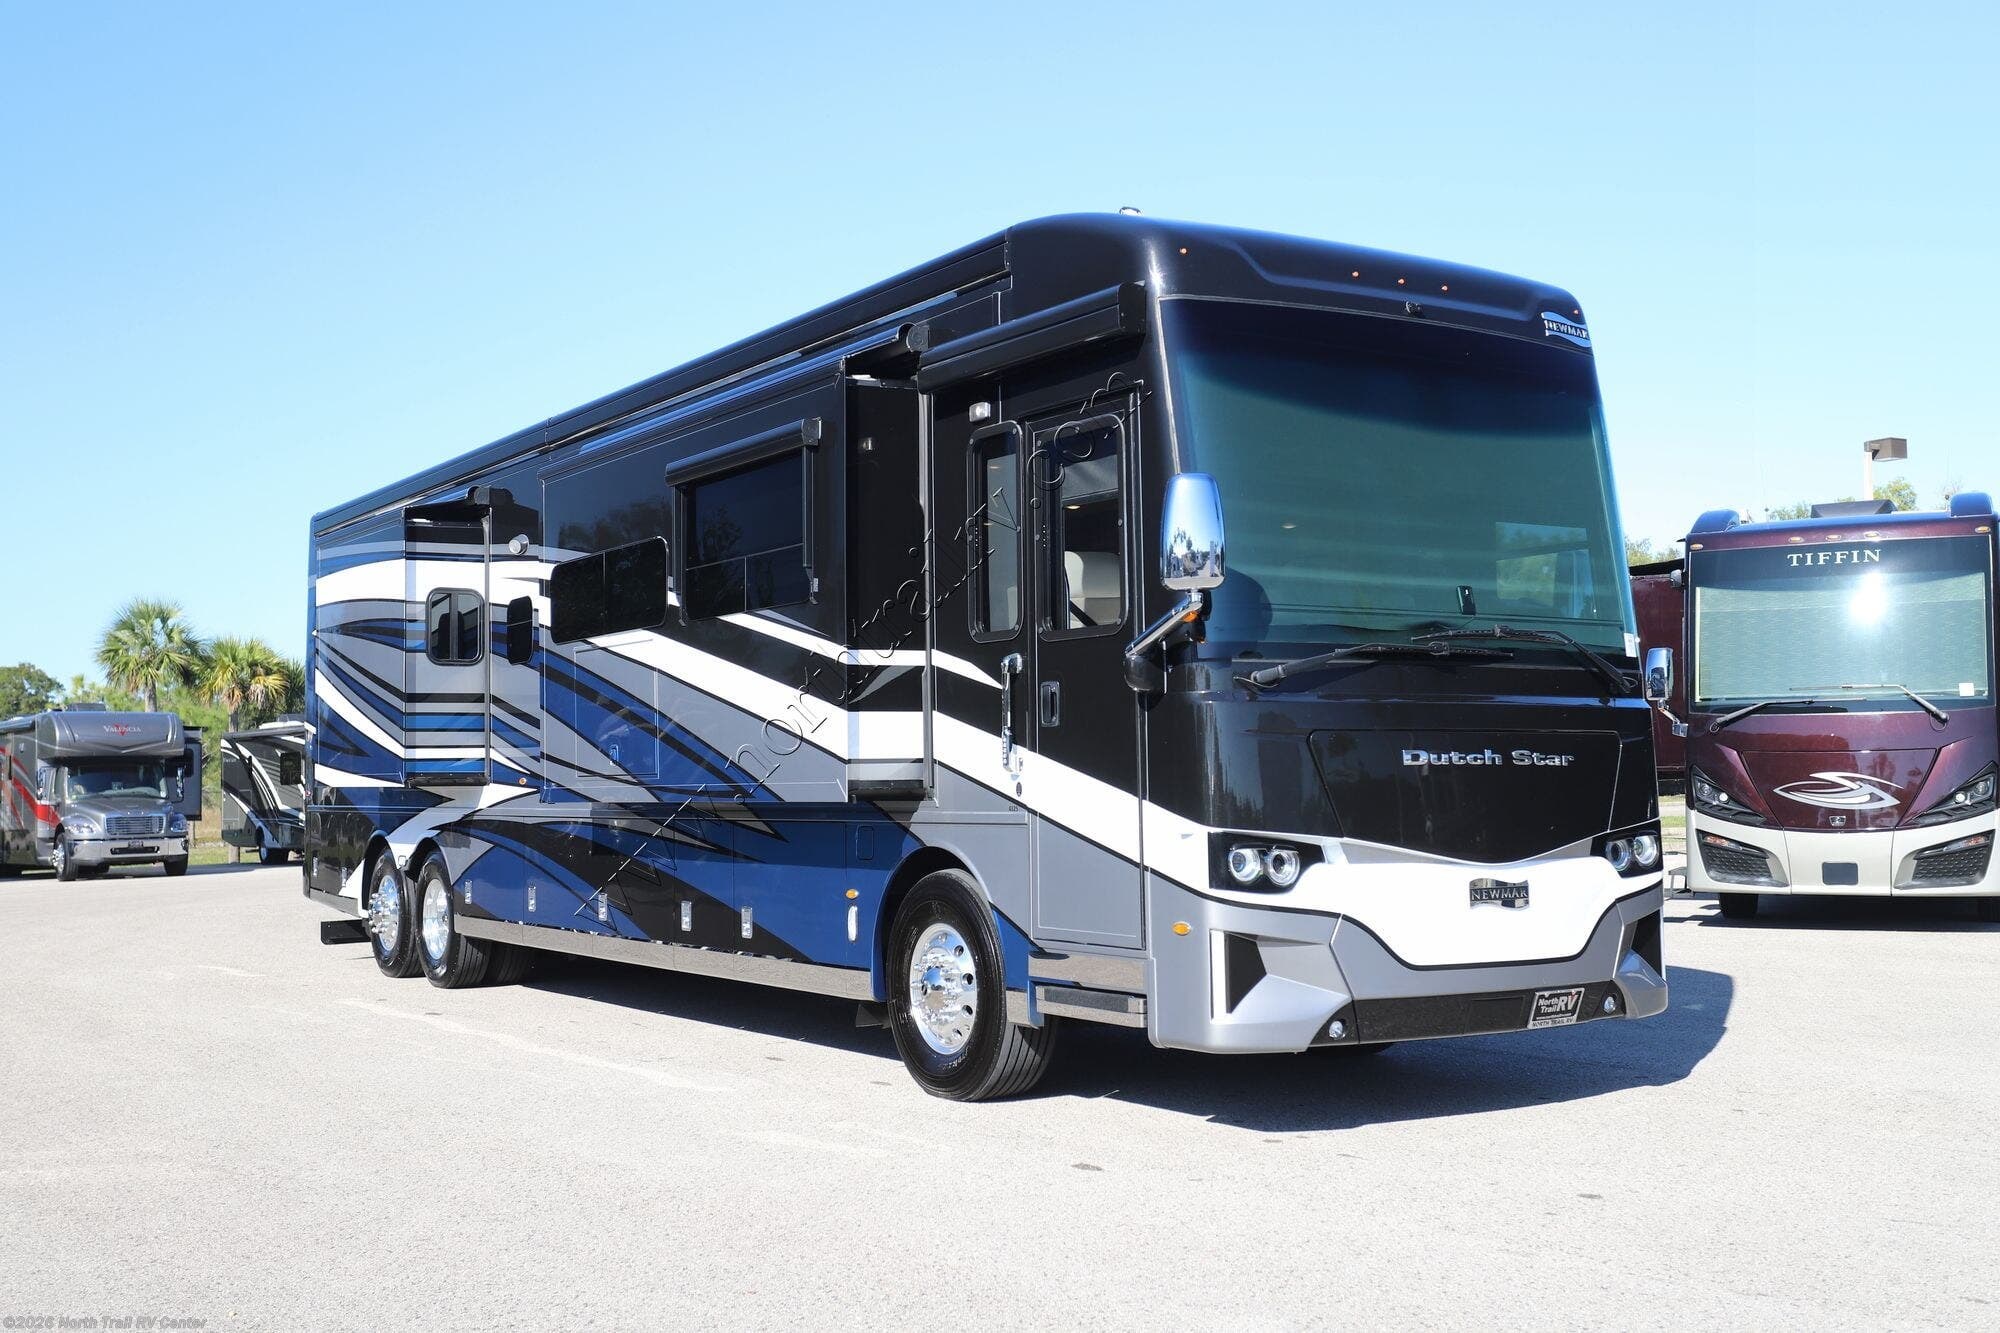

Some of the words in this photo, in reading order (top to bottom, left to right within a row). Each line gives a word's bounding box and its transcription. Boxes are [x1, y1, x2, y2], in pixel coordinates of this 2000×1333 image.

[1787, 549, 1881, 566] TIFFIN
[1402, 749, 1502, 766] Dutch
[1511, 750, 1574, 766] Star
[1471, 888, 1528, 900] NEWMAR
[1538, 998, 1558, 1006] North
[1541, 1004, 1557, 1013] Trail
[1557, 994, 1579, 1012] RV
